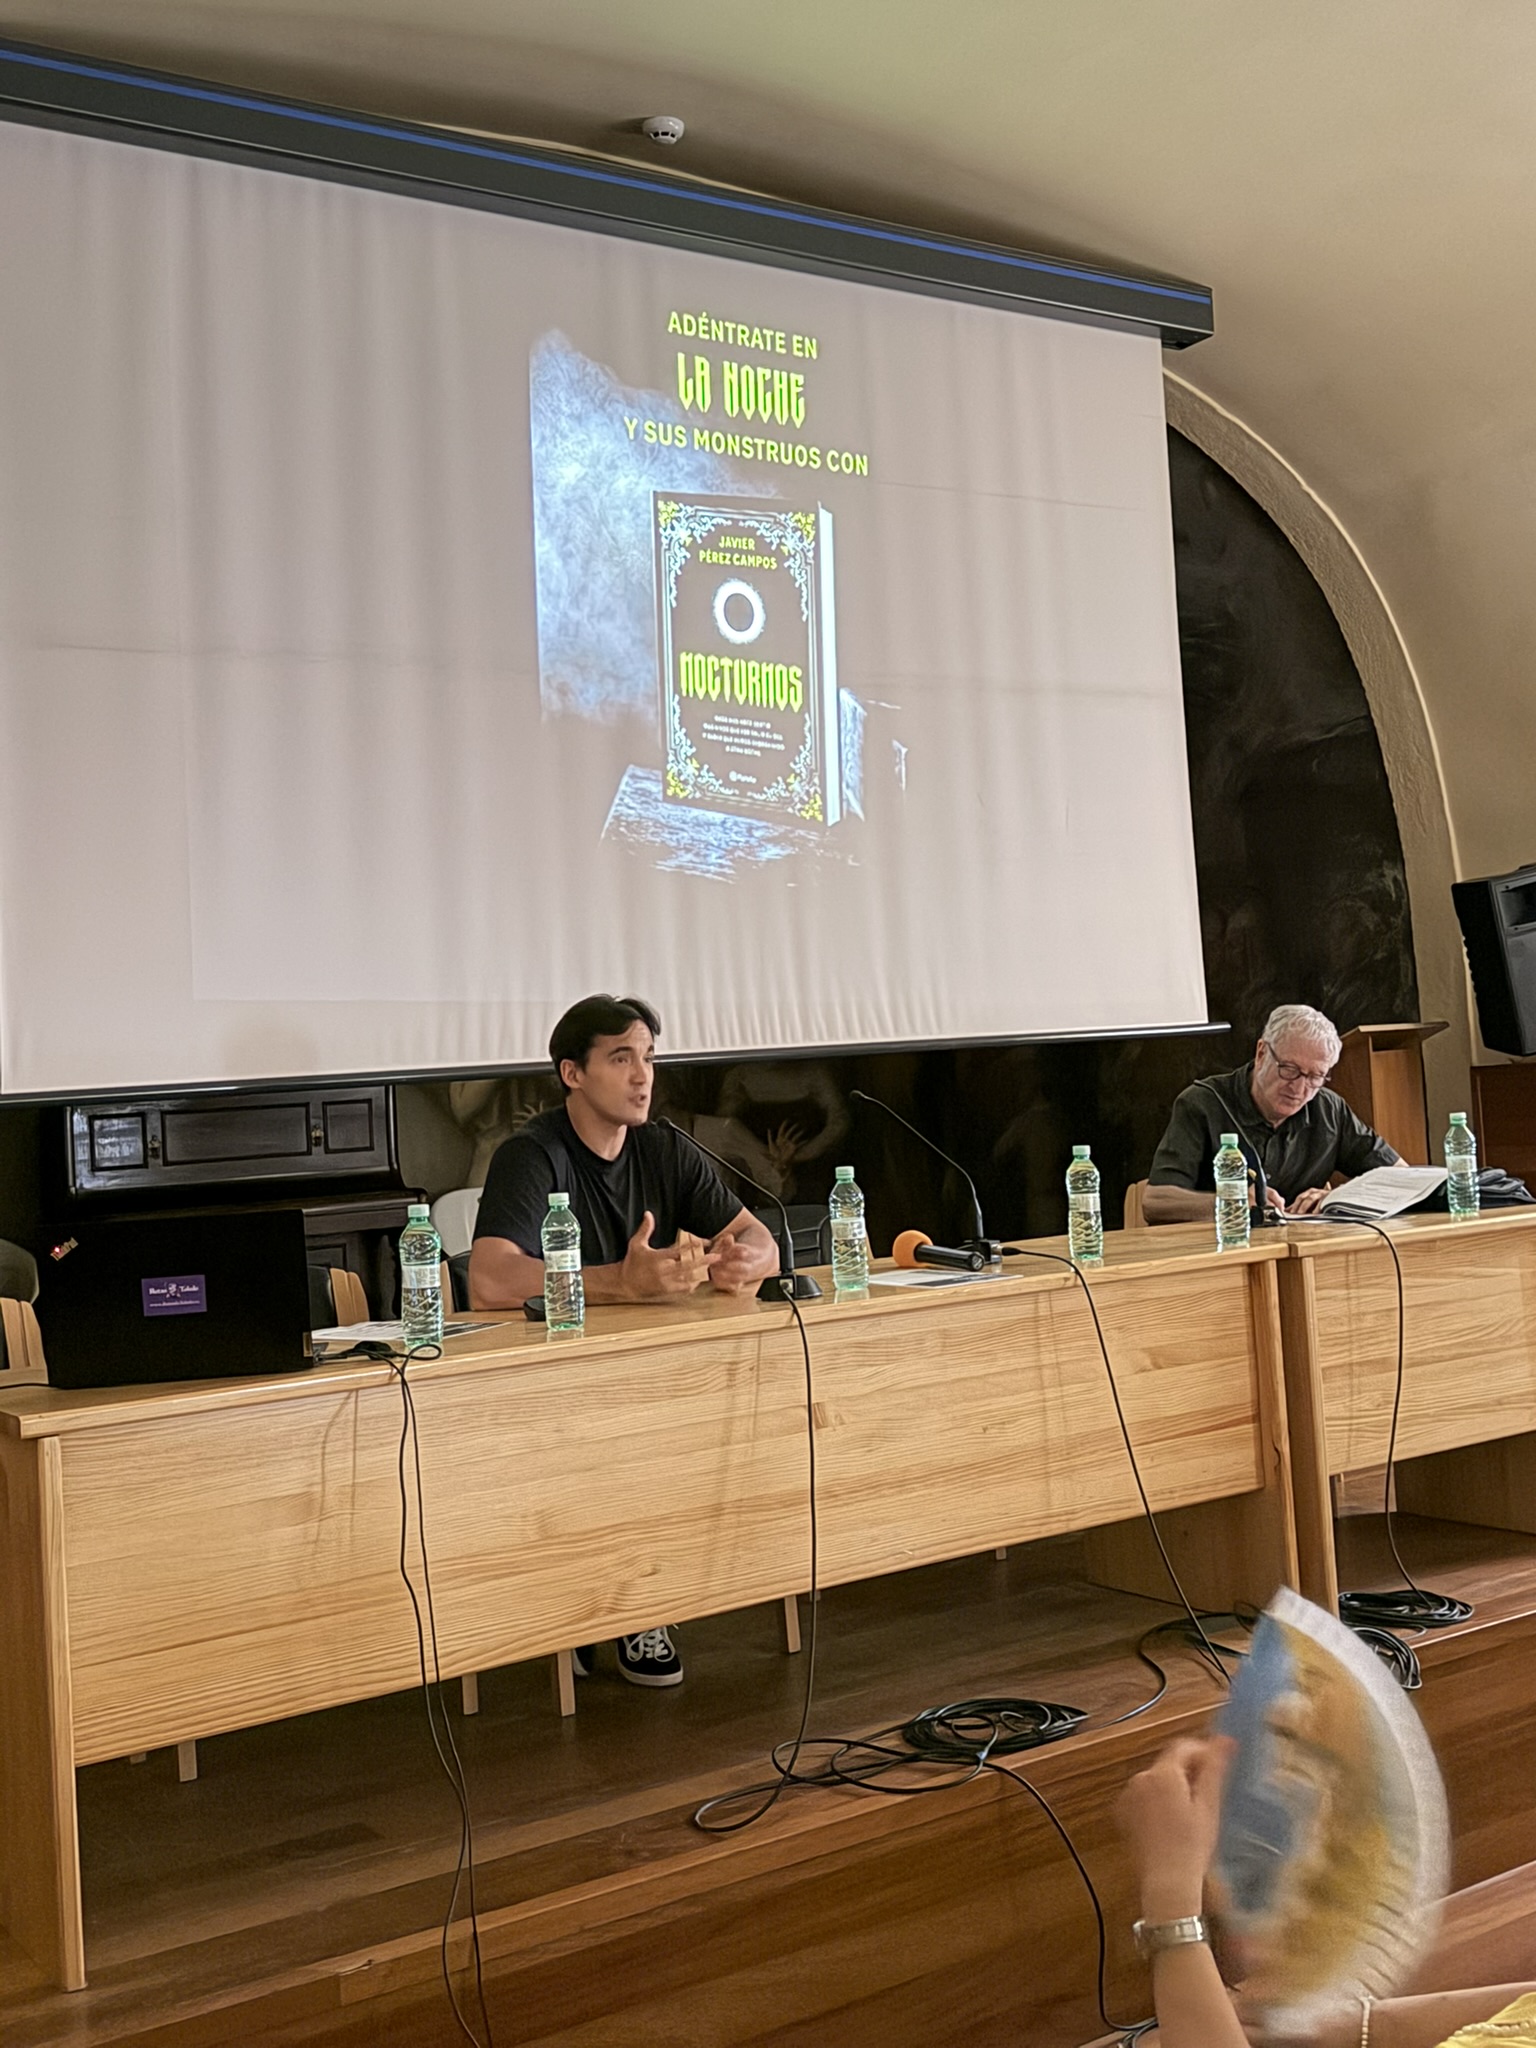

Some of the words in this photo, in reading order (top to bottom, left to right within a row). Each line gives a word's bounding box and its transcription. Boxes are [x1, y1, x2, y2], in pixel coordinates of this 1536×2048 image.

[667, 311, 788, 354] ADÉNTRATE
[792, 334, 818, 360] EN
[677, 352, 712, 413] LA
[722, 360, 806, 429] NOCHE
[623, 416, 638, 440] Y
[644, 420, 687, 448] SUS
[693, 428, 822, 469] MONSTRUOS
[826, 449, 869, 476] CON
[699, 548, 731, 565] PÉREZ
[732, 553, 778, 570] CAMPOS
[719, 536, 755, 551] JAVIER
[679, 651, 803, 713] NOCTURNOS
